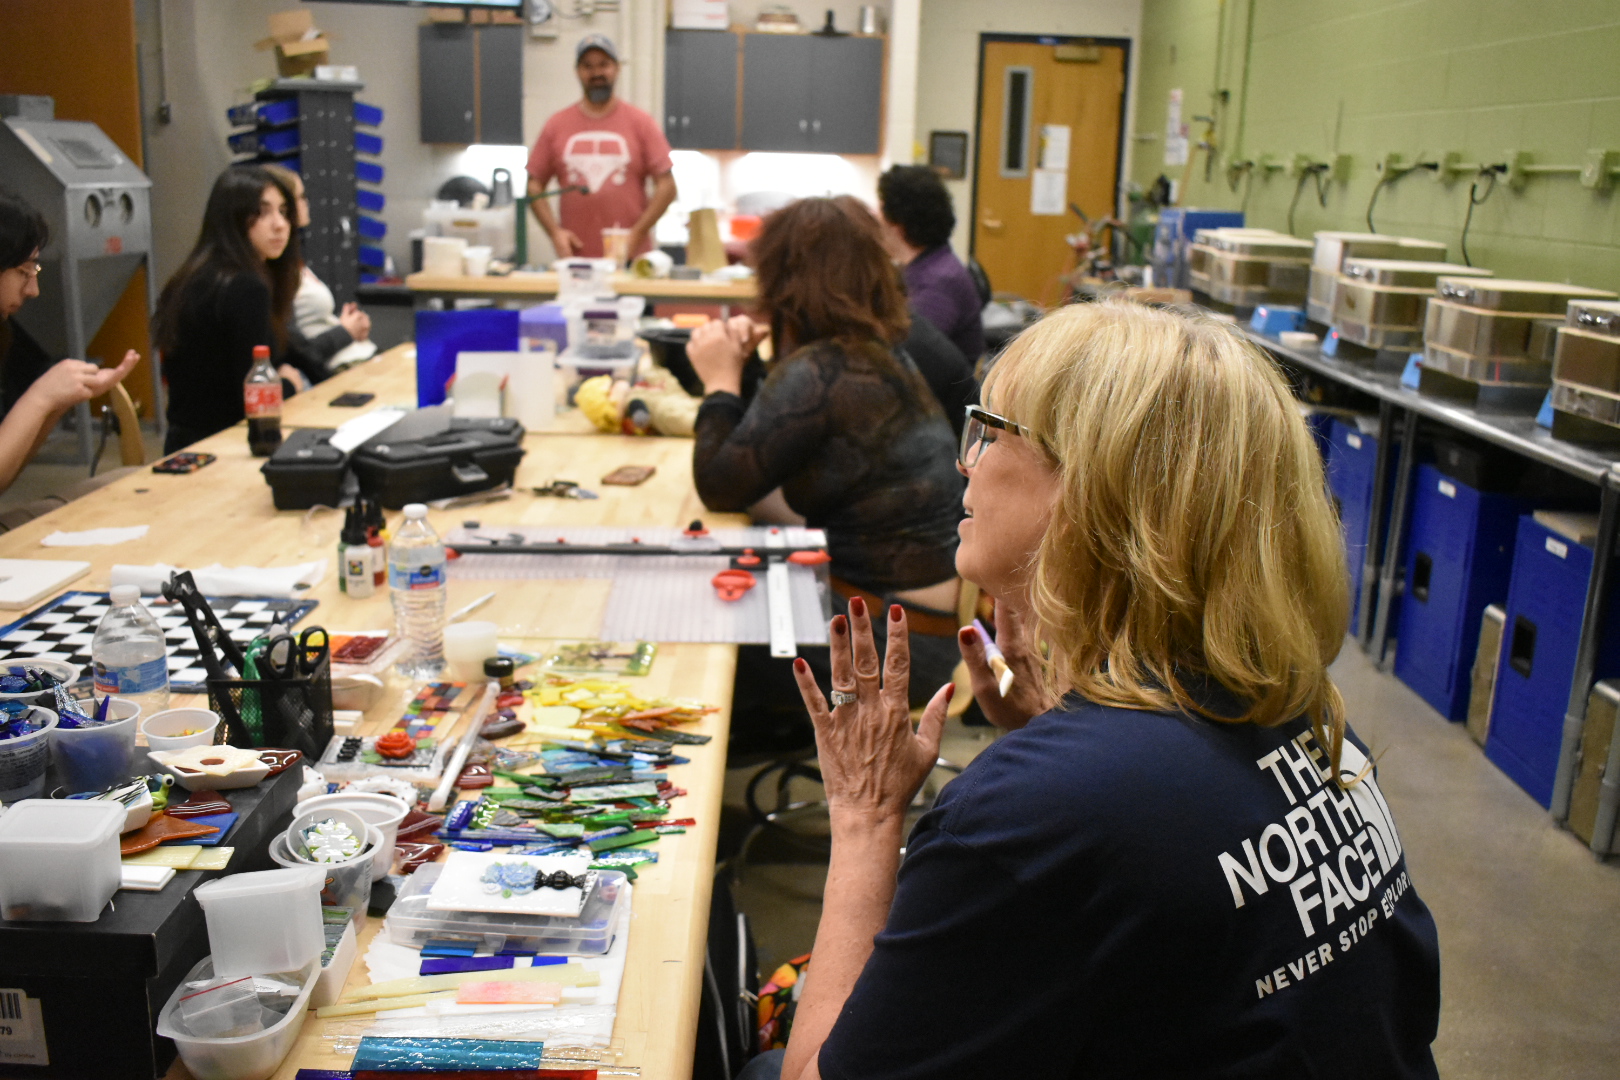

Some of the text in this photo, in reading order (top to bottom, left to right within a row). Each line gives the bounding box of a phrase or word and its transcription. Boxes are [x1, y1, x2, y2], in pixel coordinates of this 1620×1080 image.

[1256, 728, 1332, 805] THE
[1217, 785, 1364, 909] NORTH
[1289, 829, 1382, 938] FACE
[1255, 942, 1334, 999] NEVER
[1338, 907, 1378, 952] STOP
